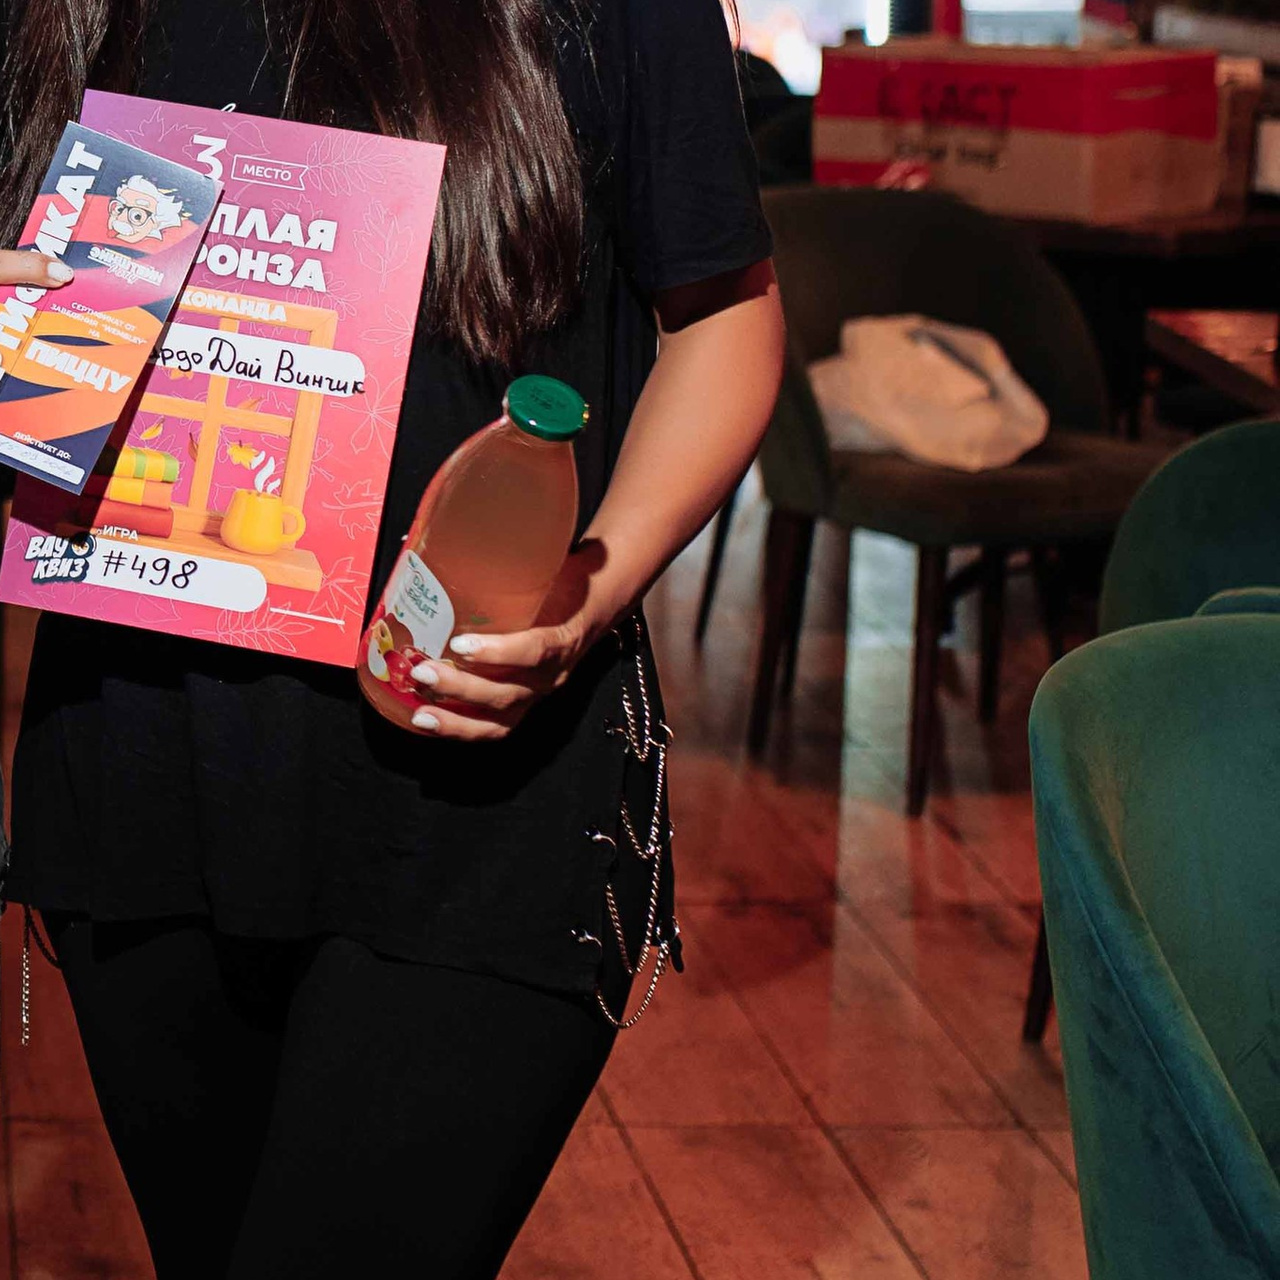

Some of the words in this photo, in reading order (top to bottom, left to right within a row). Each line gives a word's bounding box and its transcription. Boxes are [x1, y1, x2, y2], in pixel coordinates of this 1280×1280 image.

[192, 134, 228, 181] 3
[242, 162, 293, 183] МЕСТО
[208, 203, 338, 253] ПЛАЯ
[196, 243, 328, 293] ОНЗА
[180, 291, 288, 323] КОМАНДА
[24, 339, 133, 394] ПИЦЦУ
[207, 336, 263, 380] Дай
[273, 348, 366, 395] Винчик
[25, 535, 69, 560] ВАУ
[103, 524, 140, 542] ИГРА
[31, 556, 87, 580] КВИЗ
[102, 549, 198, 589] #498
